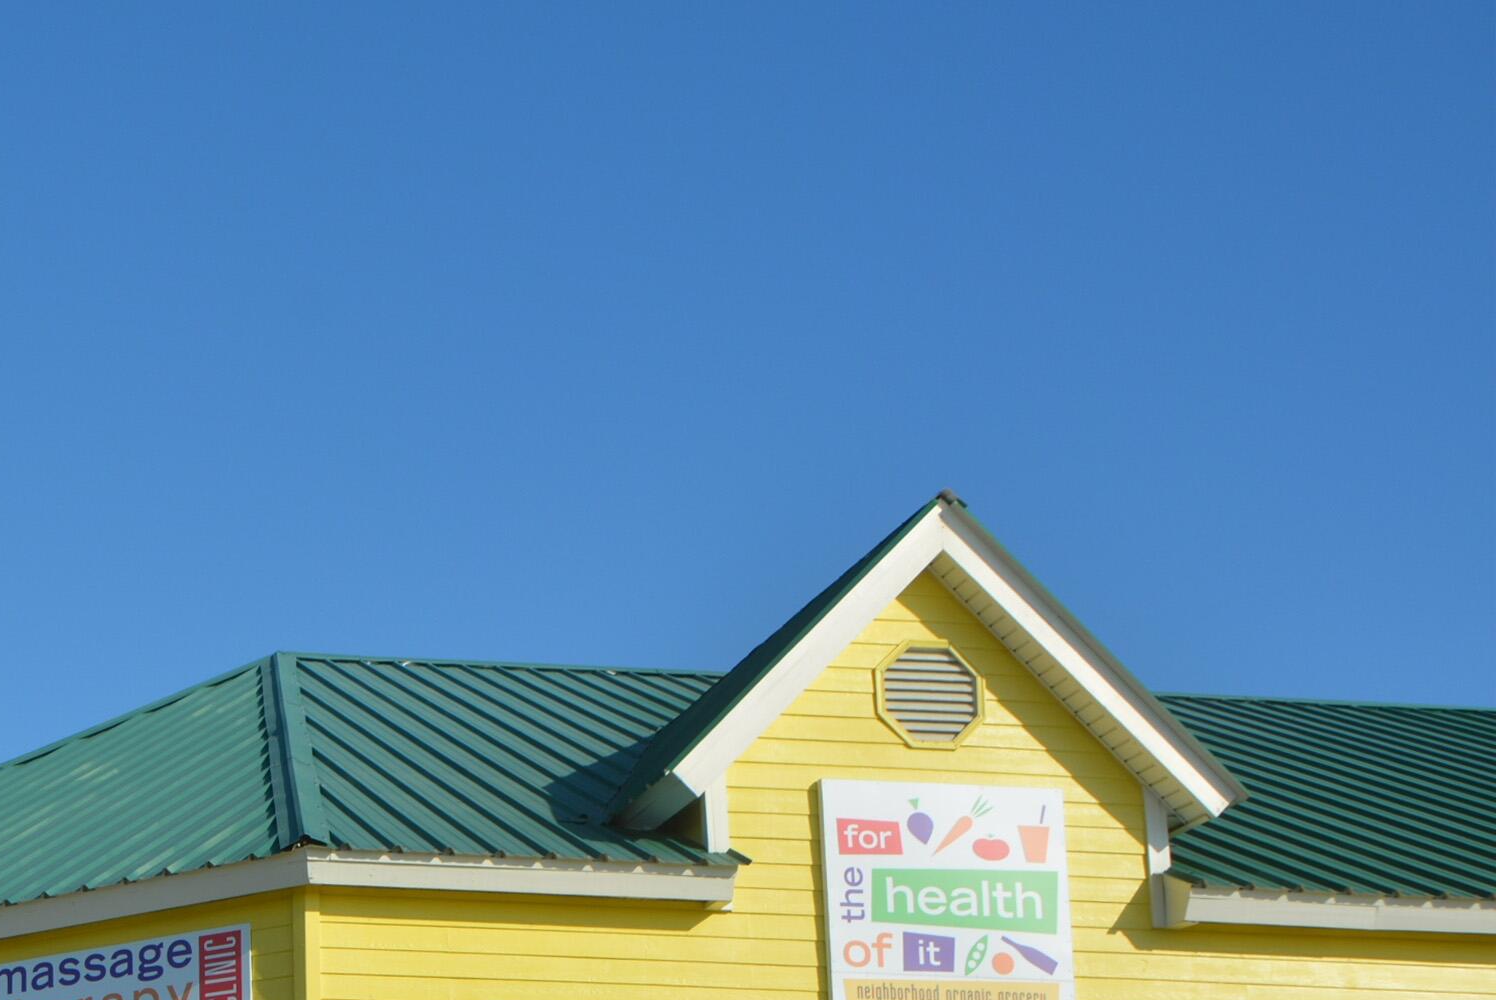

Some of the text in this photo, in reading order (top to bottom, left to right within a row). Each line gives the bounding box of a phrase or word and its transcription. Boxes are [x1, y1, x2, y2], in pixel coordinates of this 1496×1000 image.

[843, 824, 892, 849] for
[840, 867, 865, 923] the
[885, 876, 1044, 920] health
[843, 932, 941, 968] of it
